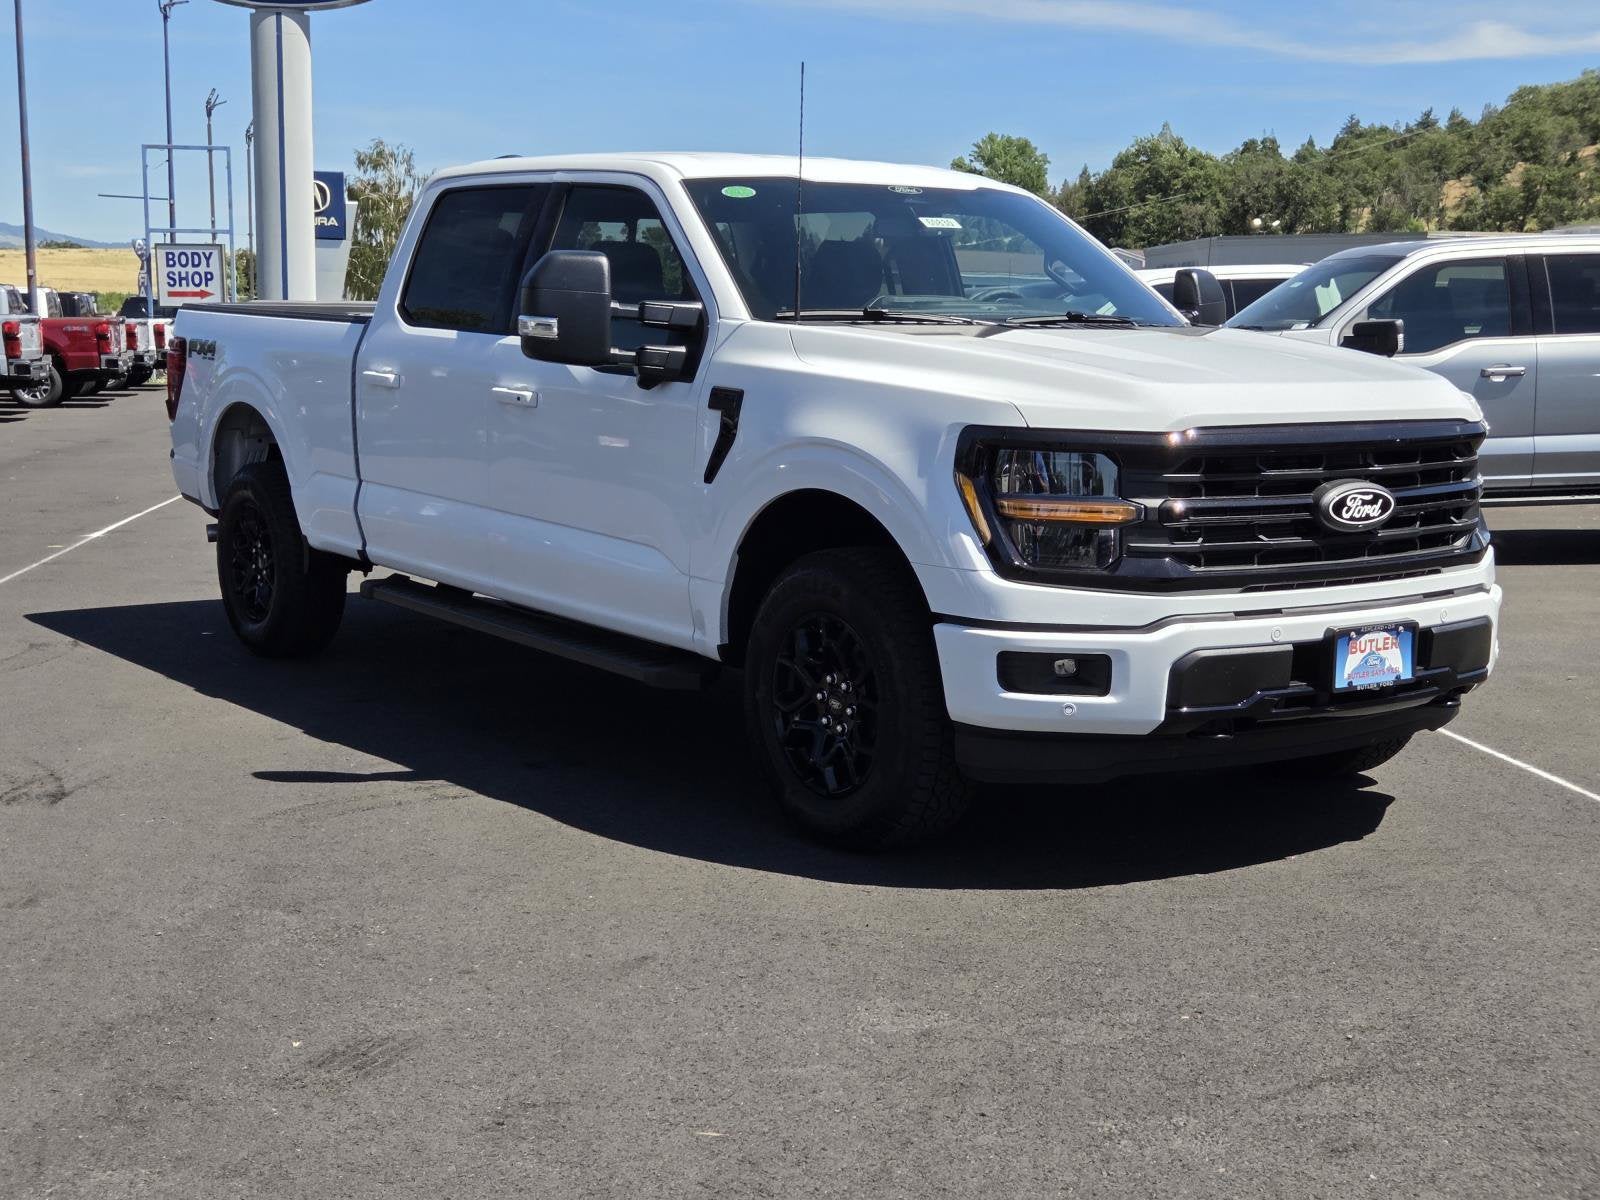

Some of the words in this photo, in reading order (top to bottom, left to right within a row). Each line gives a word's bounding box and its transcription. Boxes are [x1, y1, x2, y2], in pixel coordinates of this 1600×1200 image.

[165, 251, 214, 269] BODY
[166, 271, 215, 288] SHOP
[1342, 494, 1383, 518] Ford
[1349, 637, 1398, 654] BUTLER
[1347, 671, 1369, 680] BUTLER
[1356, 683, 1377, 691] BUTLER
